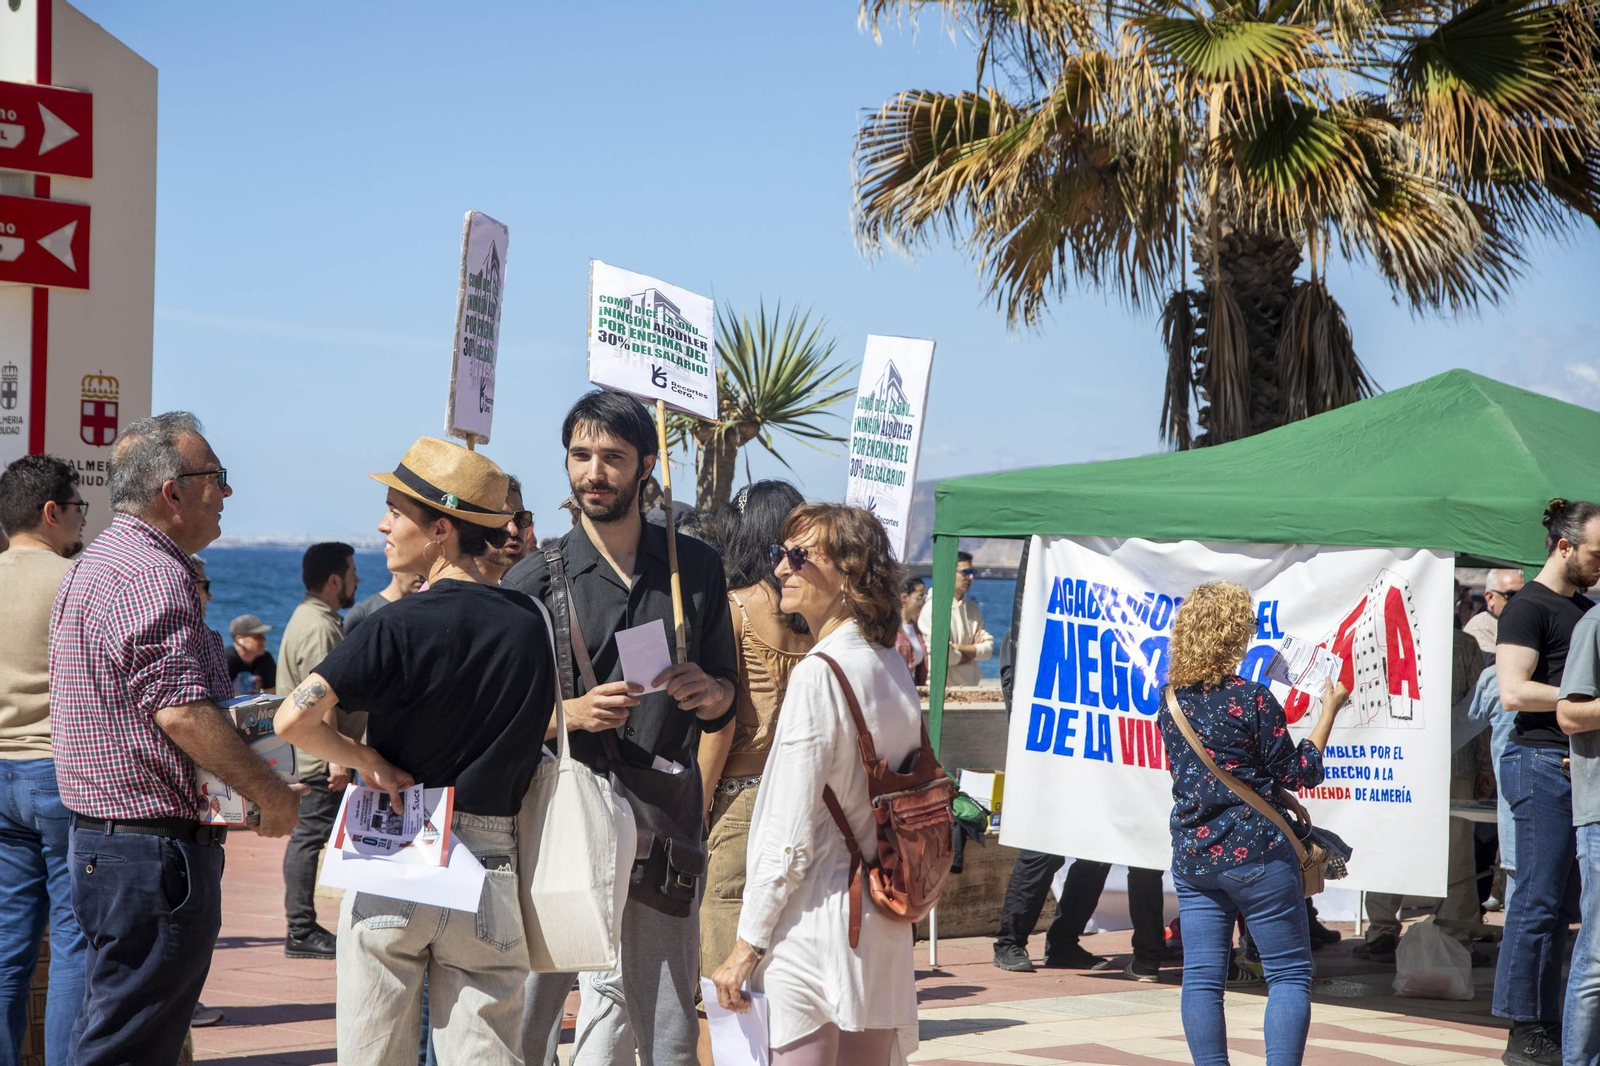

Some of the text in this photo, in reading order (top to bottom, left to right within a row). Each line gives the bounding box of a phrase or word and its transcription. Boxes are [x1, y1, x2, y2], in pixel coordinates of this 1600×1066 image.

[599, 295, 630, 309] COMO
[635, 305, 658, 319] DICE
[663, 316, 674, 325] LA
[599, 307, 708, 351] ¡NINGÚN ALQUILER
[599, 317, 708, 364] POR ENCIMA DEL
[598, 330, 708, 377] 30% DEL SALARIO!
[671, 381, 708, 399] Recortes
[671, 386, 695, 399] Cero.
[875, 399, 887, 413] DICE
[854, 415, 912, 440] ¡NINGÚN ALQUILER
[852, 436, 908, 463] POR ENCIMA DEL
[850, 458, 906, 487] 30% DEL SALARIO!
[1257, 600, 1285, 640] EL
[1026, 703, 1079, 757] DE
[1084, 711, 1113, 763] LA
[1323, 745, 1404, 760] MBLEA POR EL
[1325, 766, 1394, 781] ERECHO A LA
[1297, 785, 1412, 803] VIVIENDA DE ALMERÍA
